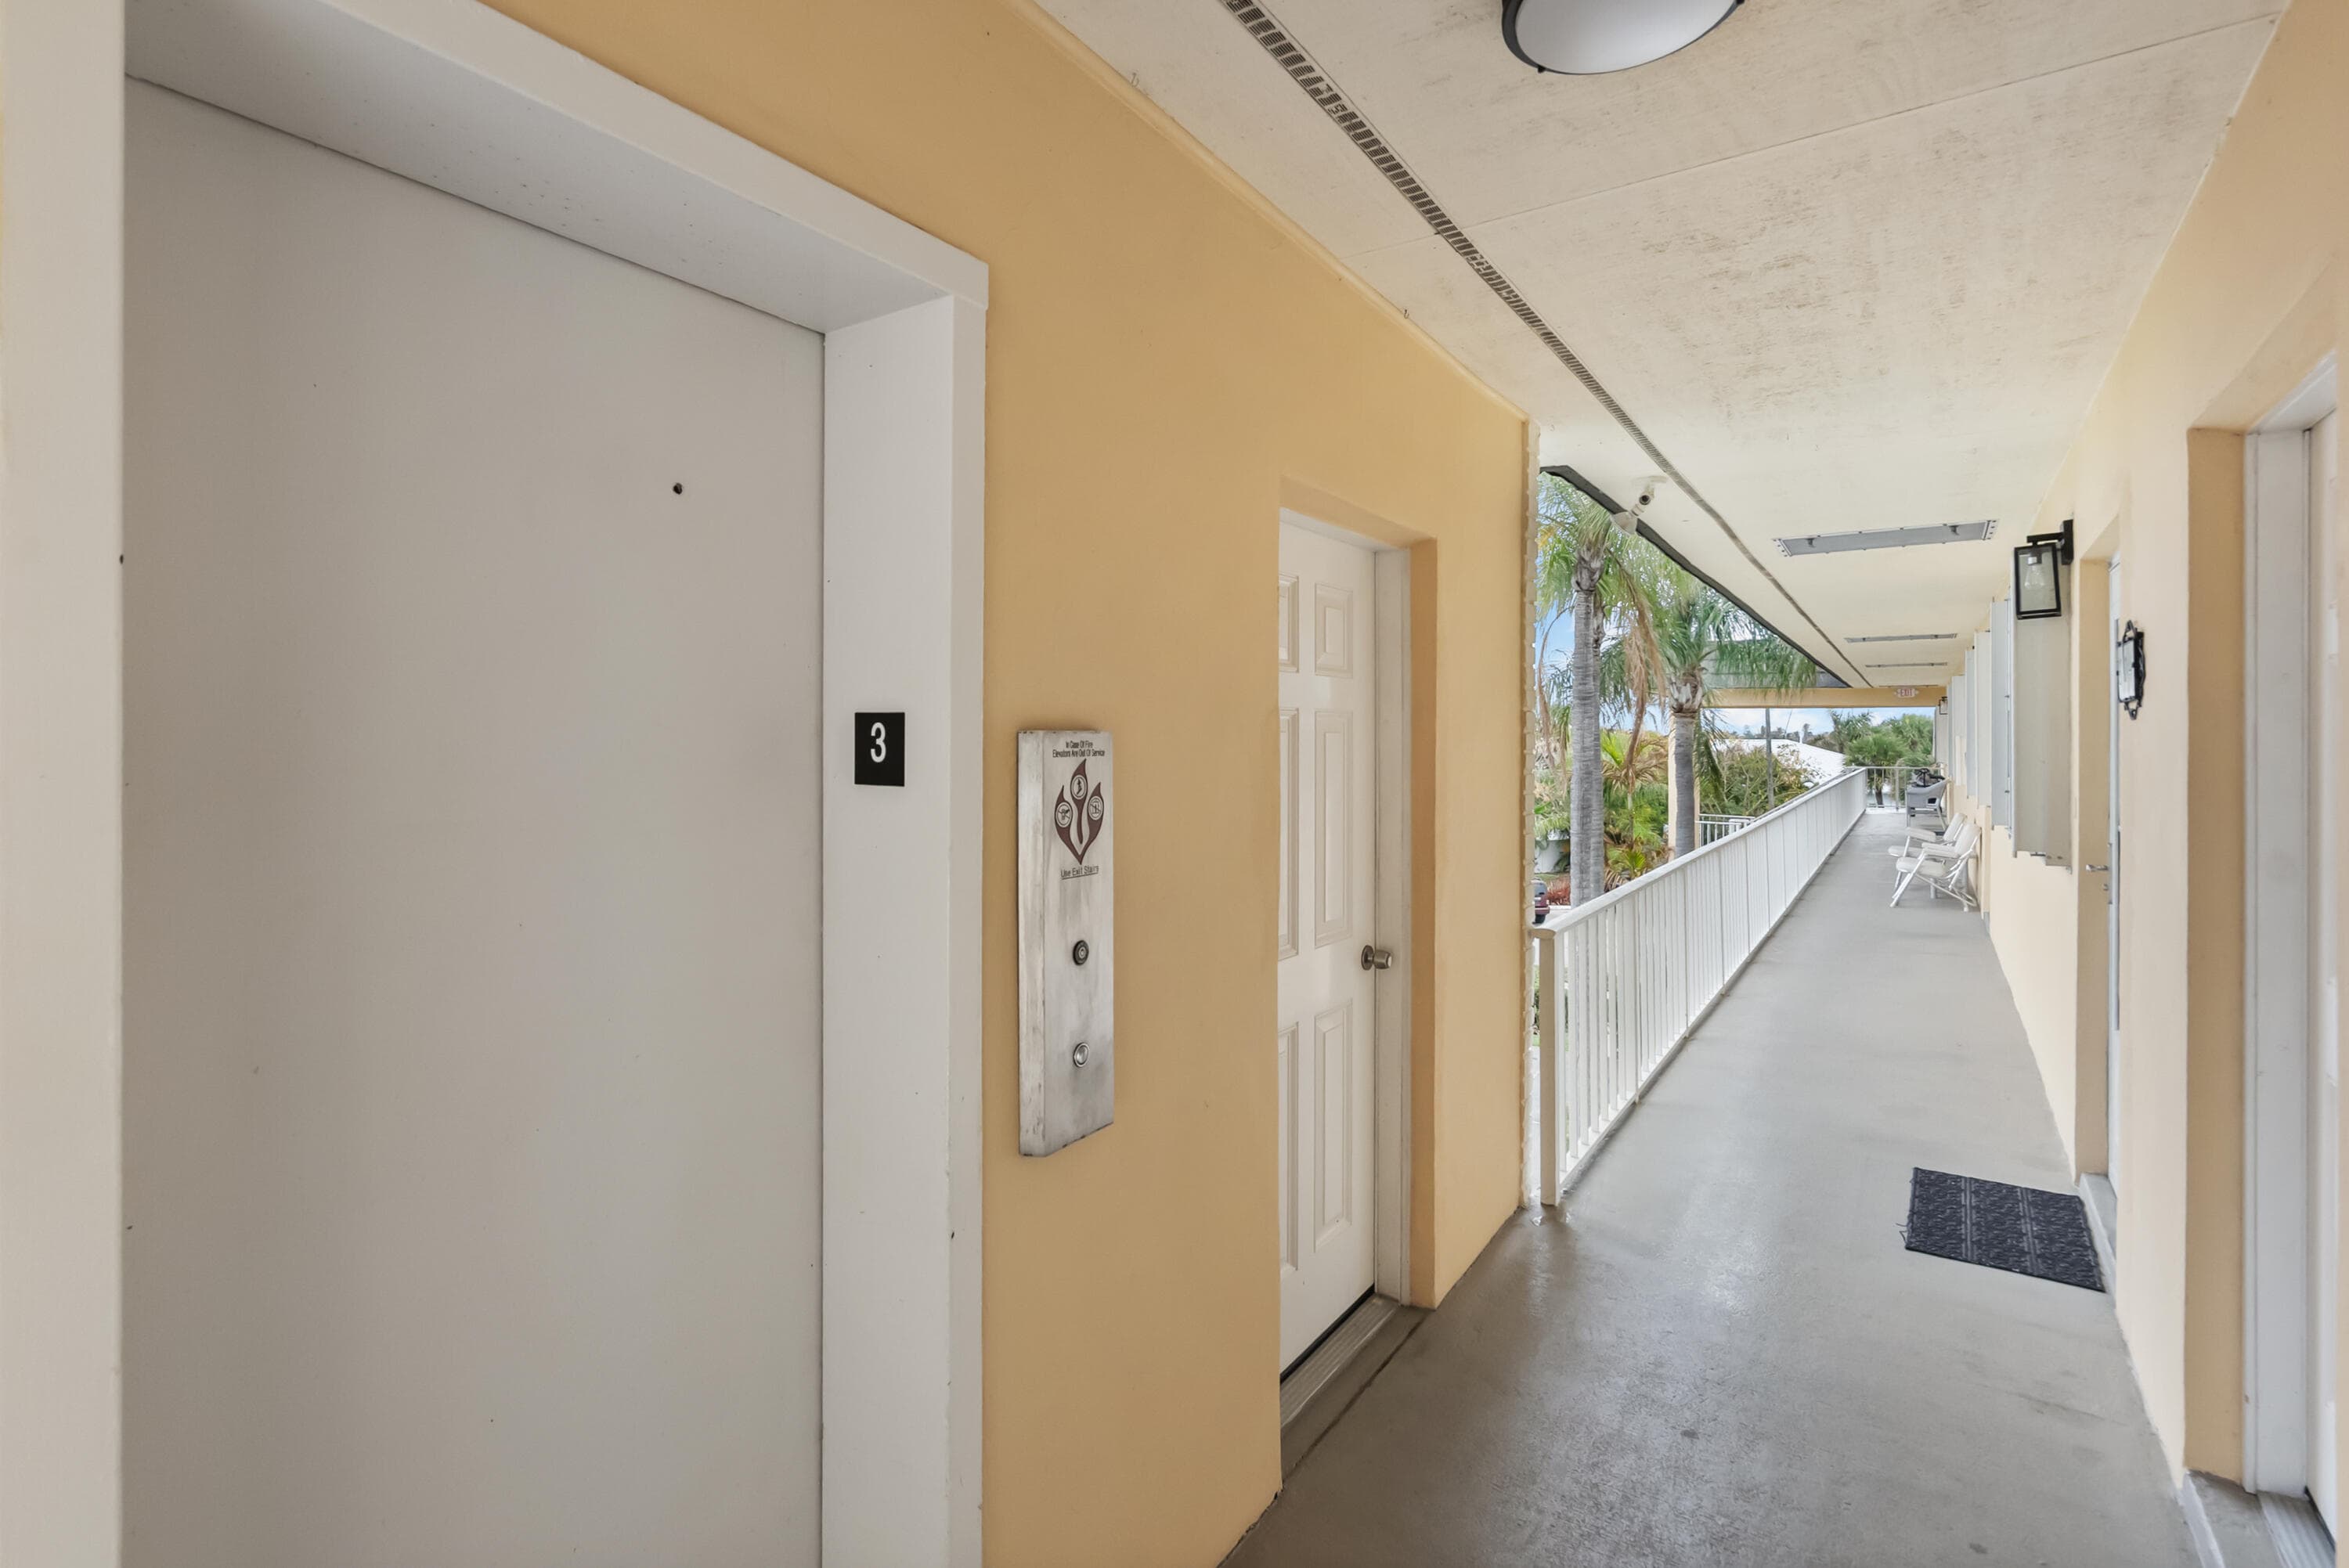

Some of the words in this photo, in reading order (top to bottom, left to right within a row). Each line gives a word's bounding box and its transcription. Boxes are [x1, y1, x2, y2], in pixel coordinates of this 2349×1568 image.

[871, 722, 886, 762] 3
[1080, 740, 1085, 748] Of
[1052, 749, 1070, 758] Elevators
[1086, 748, 1091, 757] Of
[1061, 868, 1071, 878] Use
[1072, 867, 1083, 876] Exit
[1084, 865, 1099, 874] Stairs
